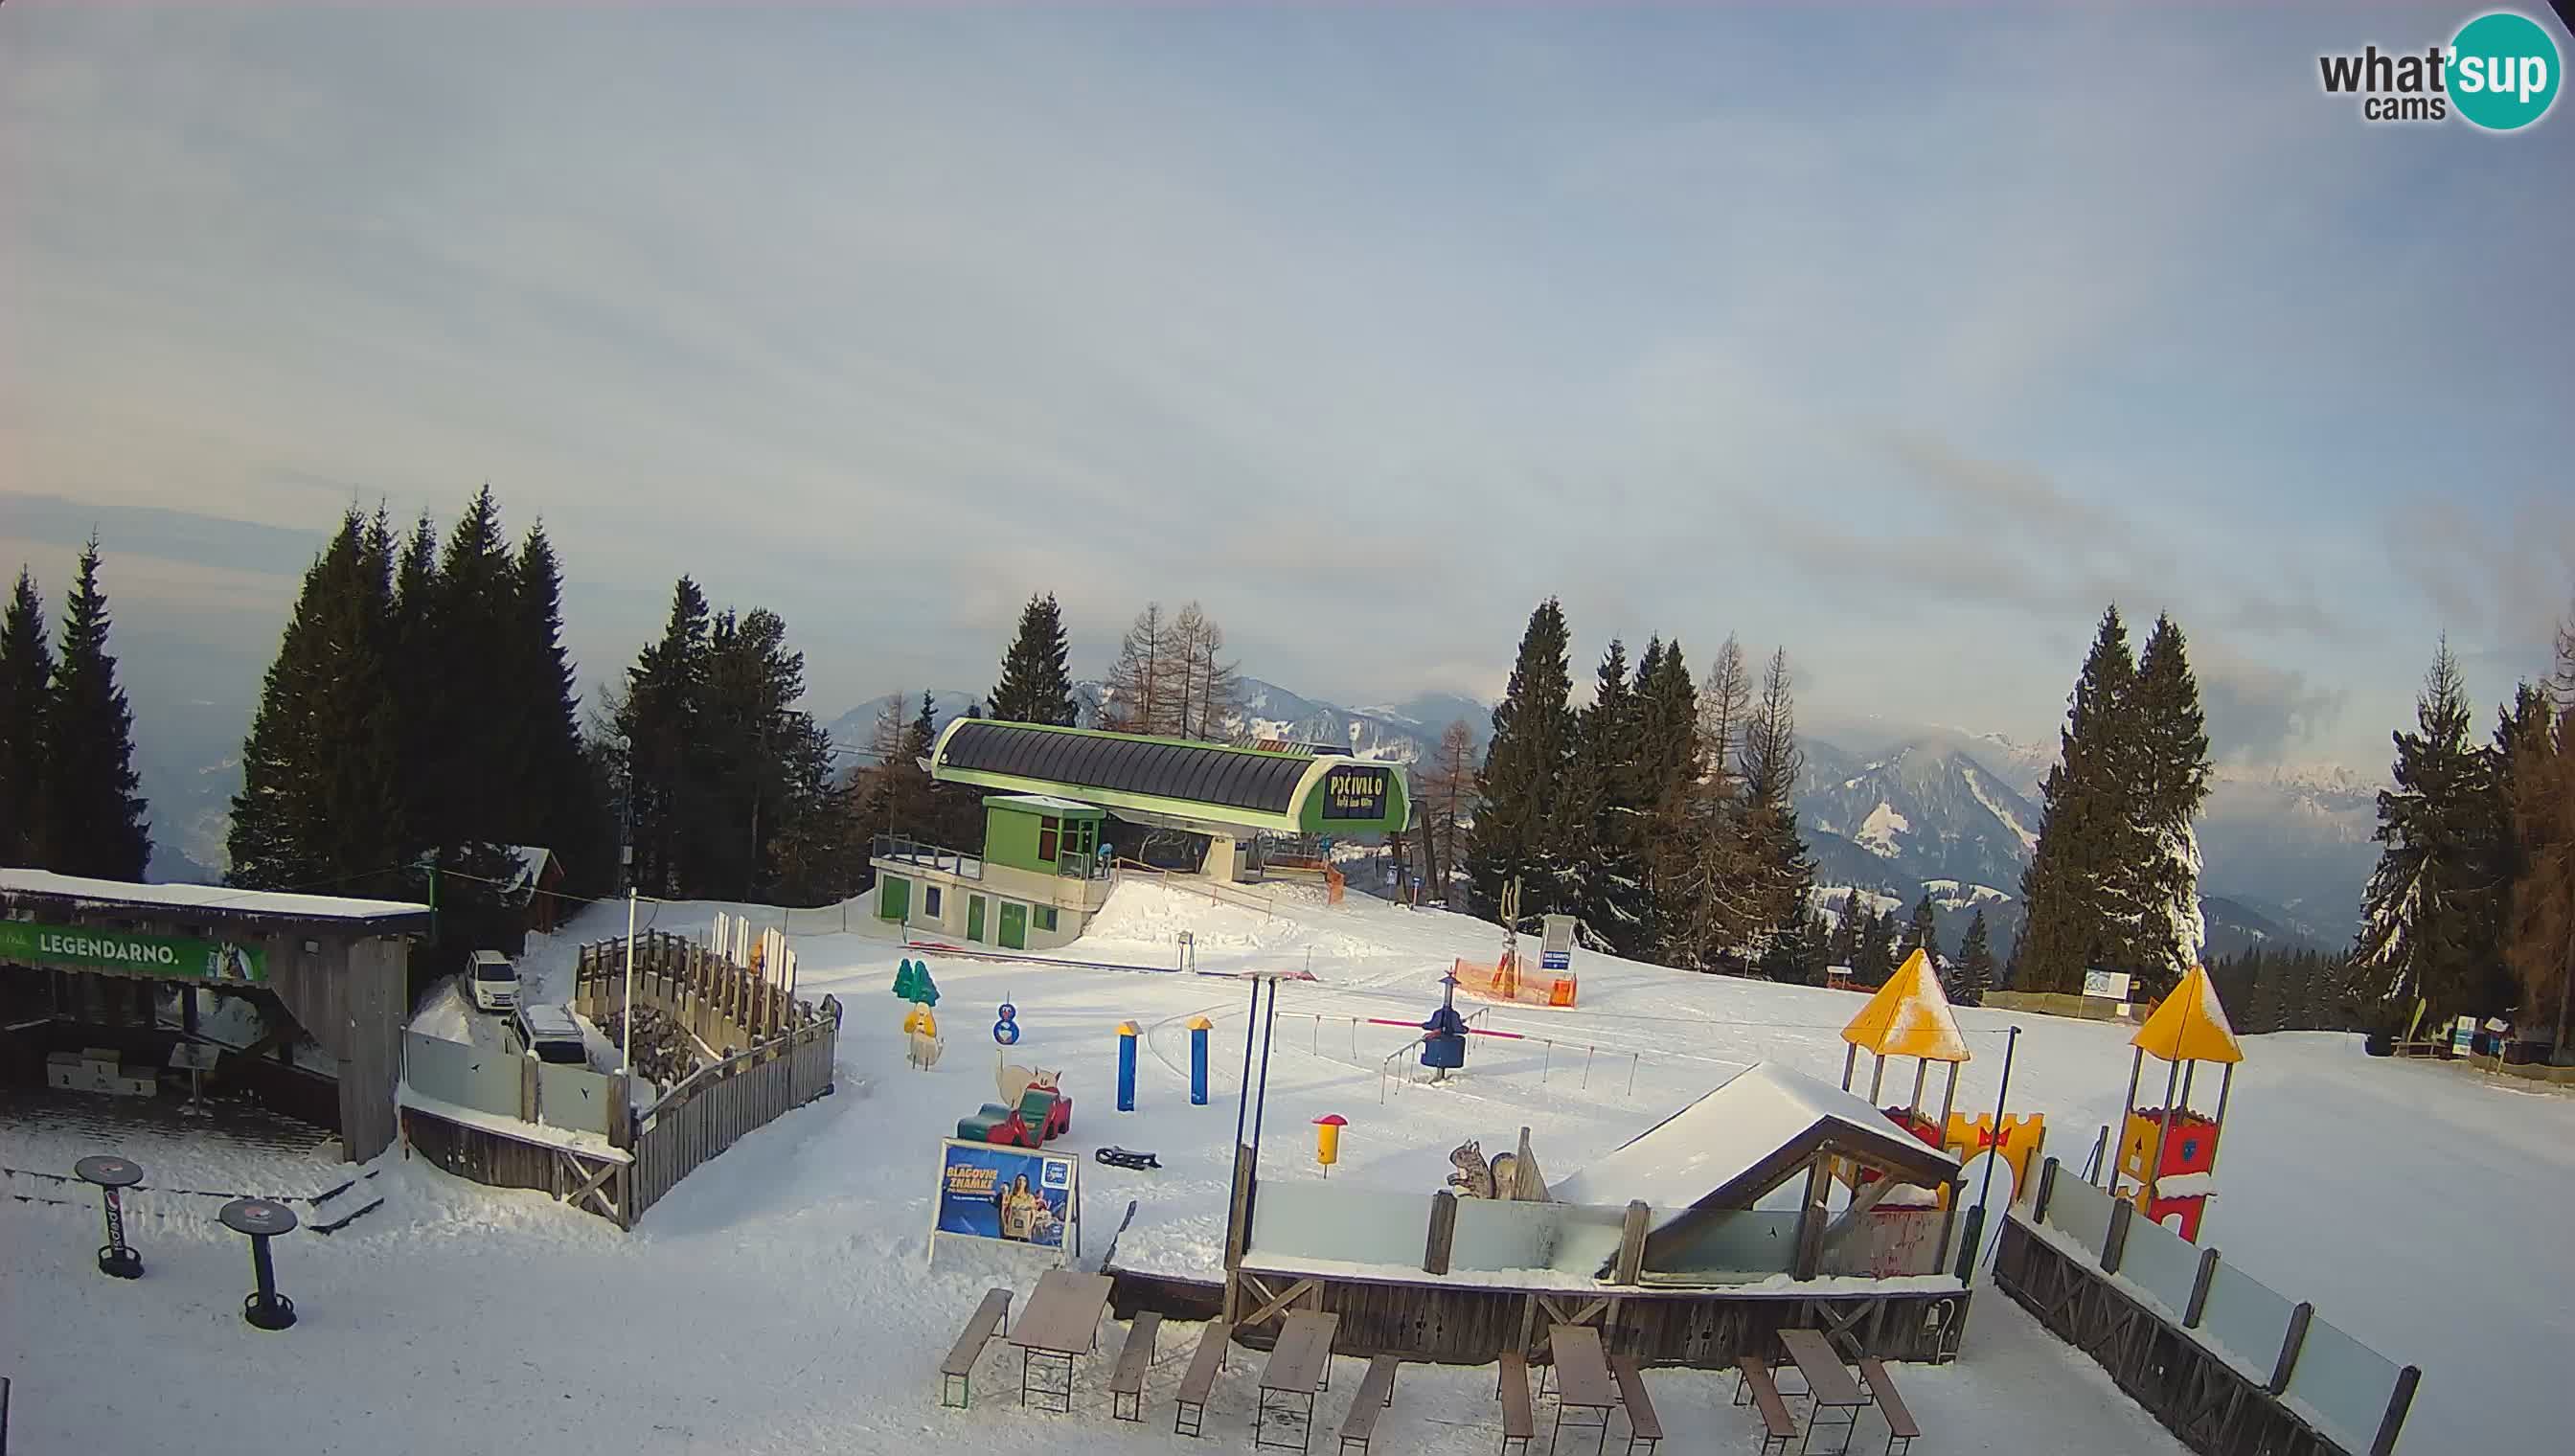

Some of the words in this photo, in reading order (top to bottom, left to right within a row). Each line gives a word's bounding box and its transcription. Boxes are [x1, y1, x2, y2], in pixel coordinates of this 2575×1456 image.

[40, 933, 179, 965] LEGENDARNO.
[946, 1167, 998, 1180] BLAGOVNE
[949, 1177, 994, 1190] ZNAMKE
[107, 1209, 123, 1250] pepsi
